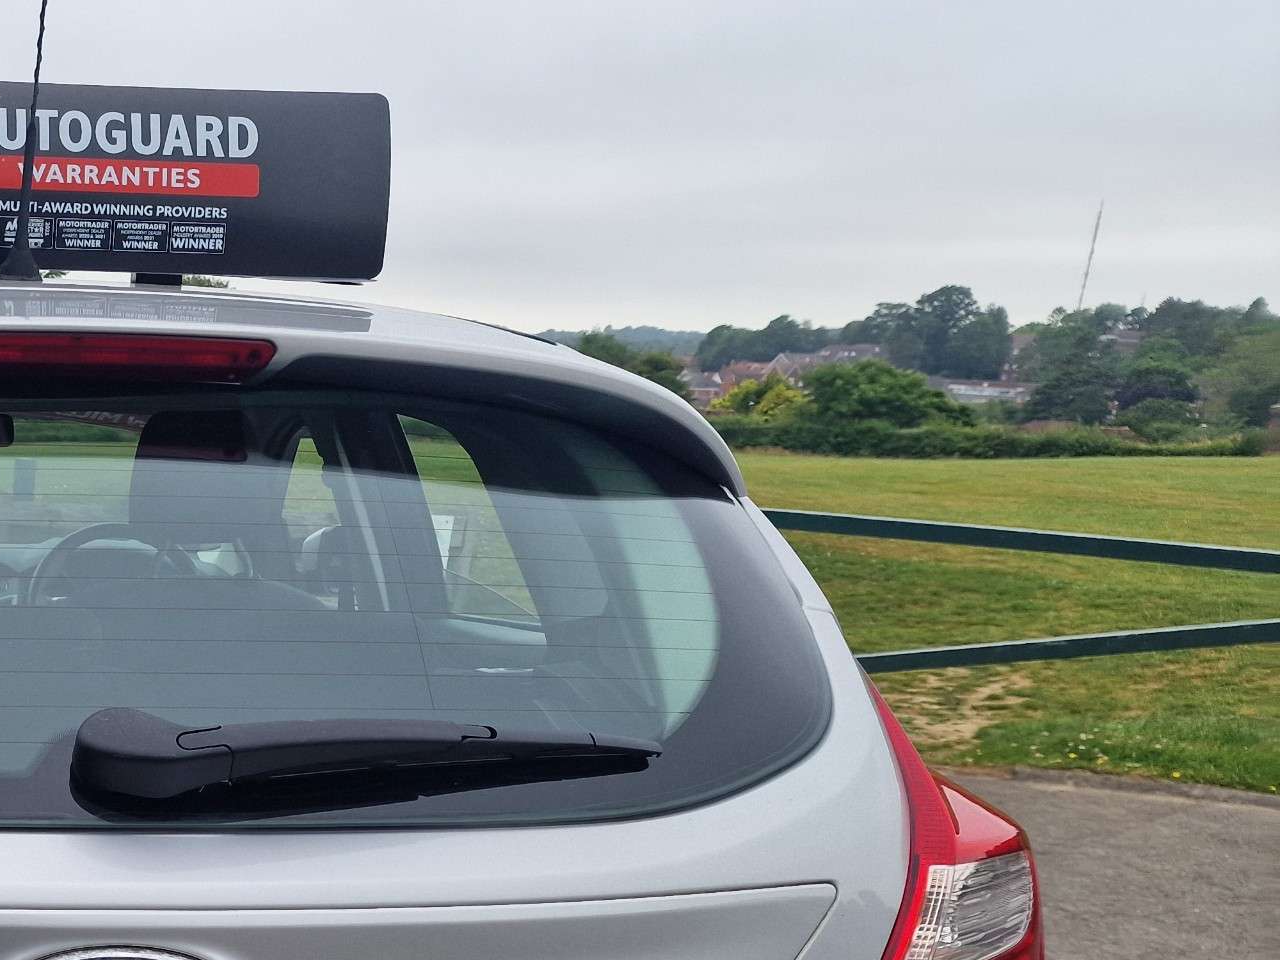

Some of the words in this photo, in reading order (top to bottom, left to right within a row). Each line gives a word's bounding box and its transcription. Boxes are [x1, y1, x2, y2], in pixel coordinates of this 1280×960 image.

[17, 163, 201, 188] WARRANTIES
[93, 203, 153, 216] WINNING
[156, 205, 228, 219] PROVIDERS
[64, 239, 102, 247] WINNER
[122, 240, 159, 249] WINNER
[172, 238, 224, 250] WINNER
